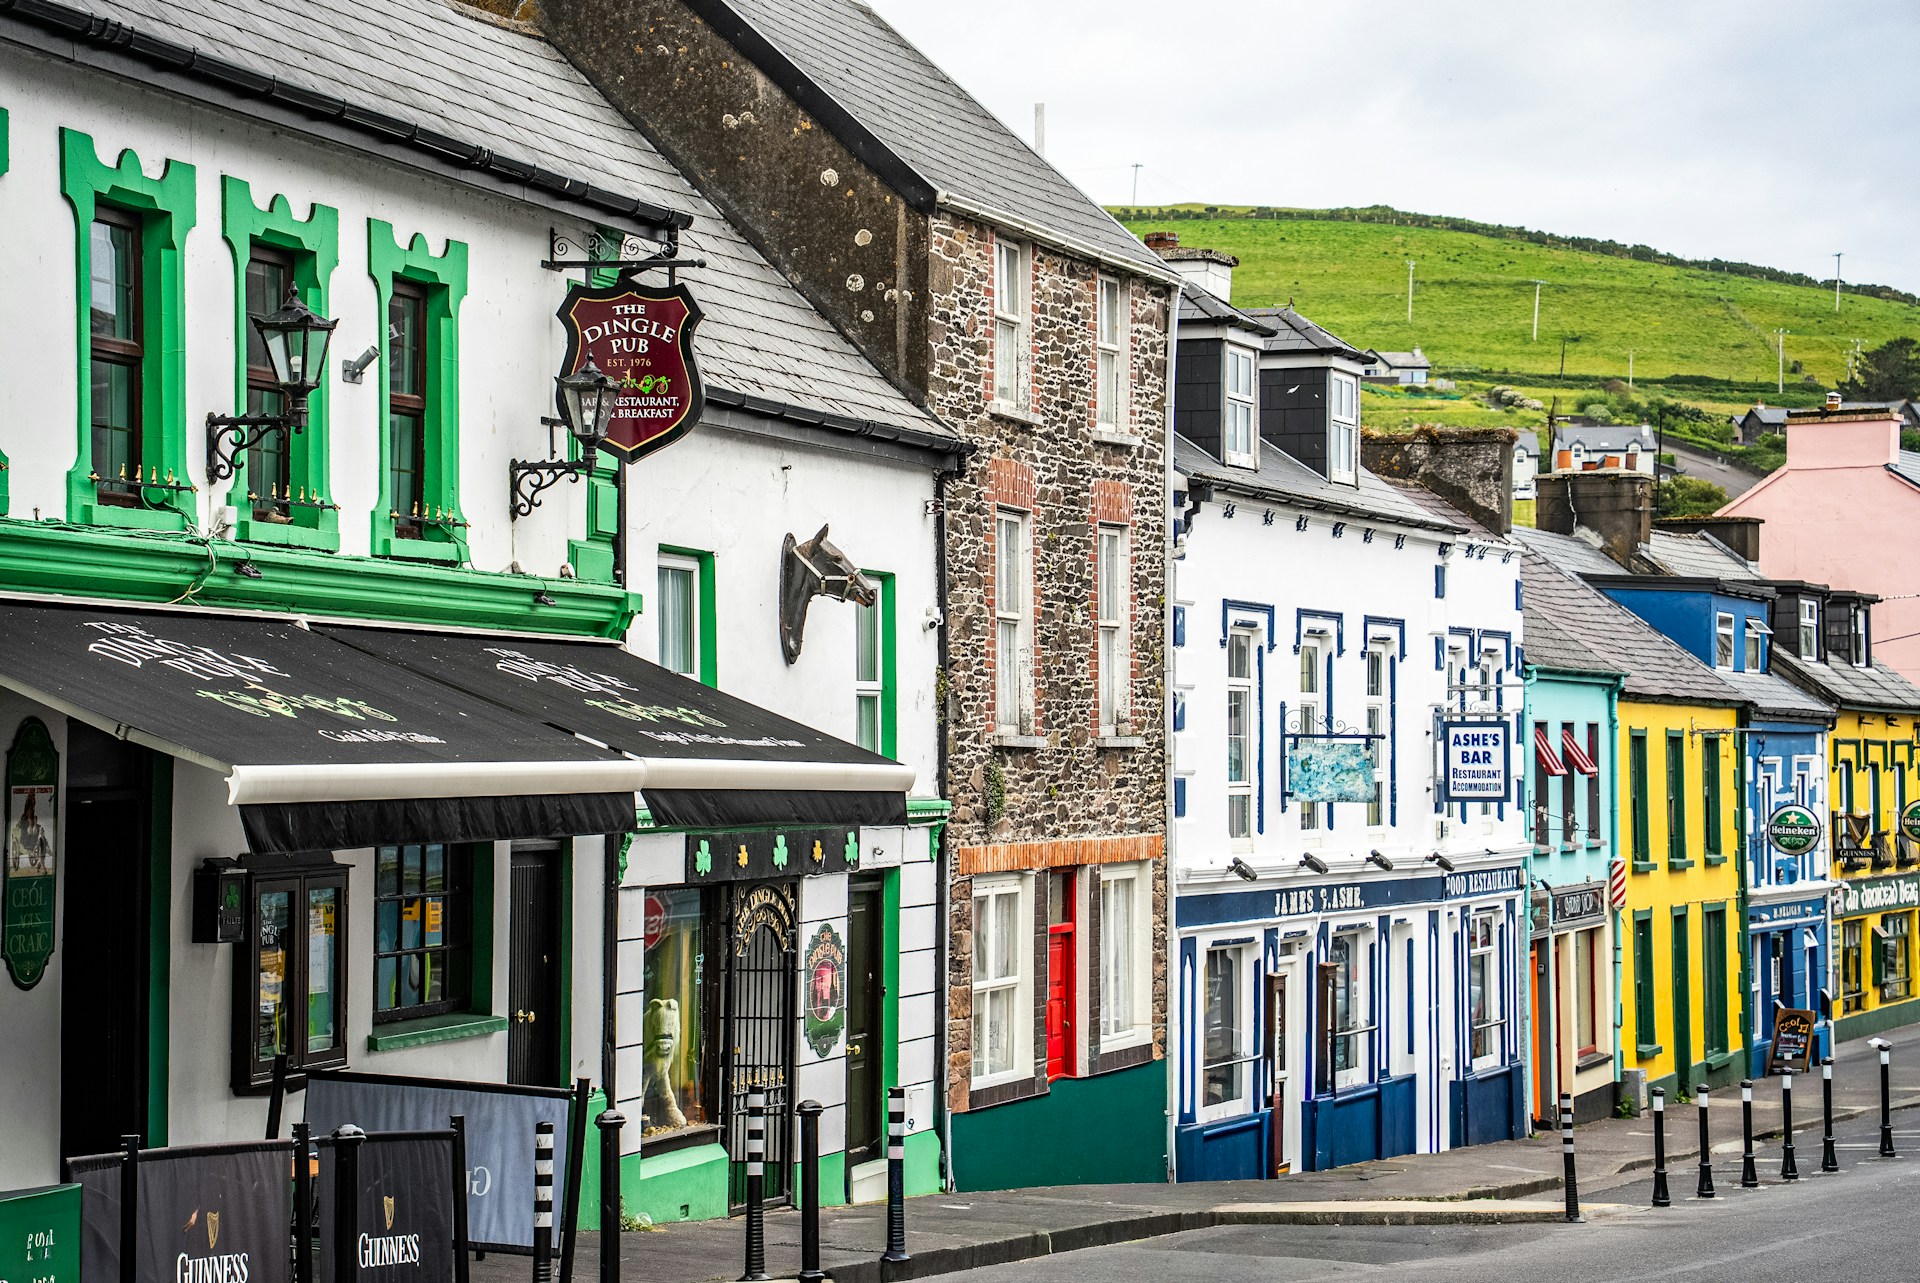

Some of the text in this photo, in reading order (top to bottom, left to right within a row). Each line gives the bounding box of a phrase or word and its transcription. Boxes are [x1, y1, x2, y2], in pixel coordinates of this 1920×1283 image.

[612, 304, 646, 315] THE
[582, 317, 676, 344] DINGLE
[611, 337, 649, 354] PUB
[607, 359, 651, 367] EST. 1976
[618, 409, 674, 418] BREAKFAST
[1452, 733, 1500, 746] ASHE'S
[1461, 751, 1492, 764] BAR
[1452, 767, 1501, 779] RESTAURANT
[1452, 780, 1501, 792] ACCOMMODATION
[1771, 825, 1816, 836] Heineken
[1840, 849, 1875, 857] GUINNESS
[1446, 869, 1517, 896] FOOD RESTAURANT
[1274, 888, 1314, 916] JAMES
[9, 932, 48, 954] CRAIC
[358, 1232, 420, 1268] GUINNESS
[176, 1252, 249, 1283] GUINNESS
